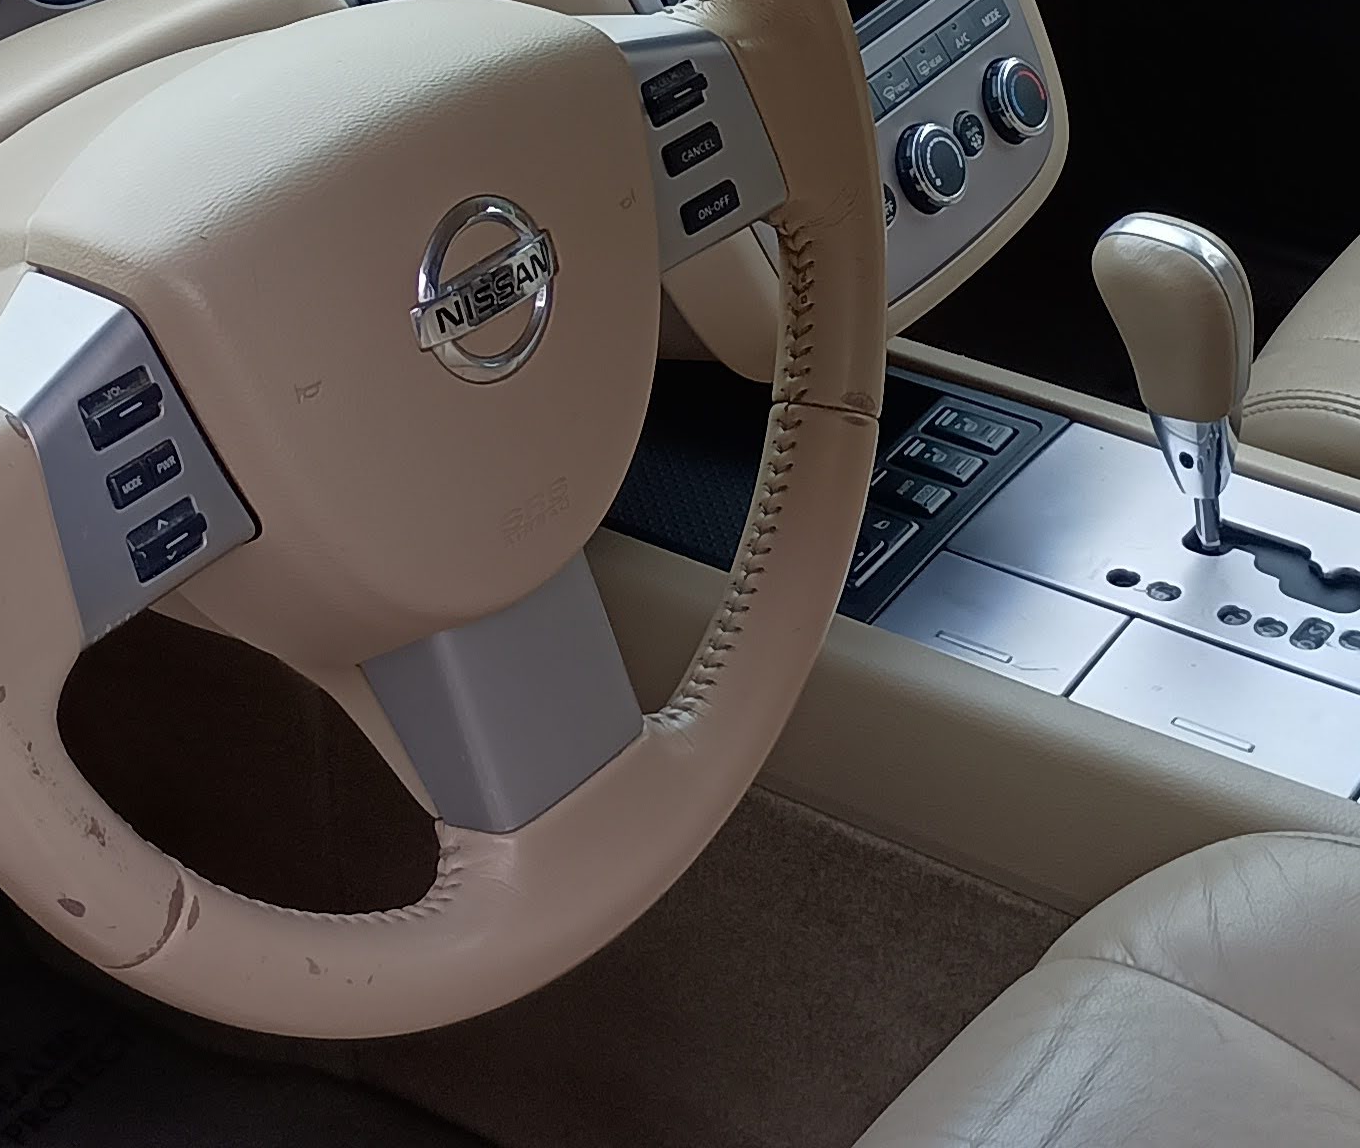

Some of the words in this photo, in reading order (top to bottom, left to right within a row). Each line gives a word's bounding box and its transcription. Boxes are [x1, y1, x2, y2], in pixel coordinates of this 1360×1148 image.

[982, 8, 1002, 27] MODE
[954, 32, 970, 49] A/C
[681, 138, 716, 163] CANCEL
[697, 194, 730, 220] ON-OFF
[435, 237, 550, 334] NISSAN
[156, 455, 178, 475] PWR
